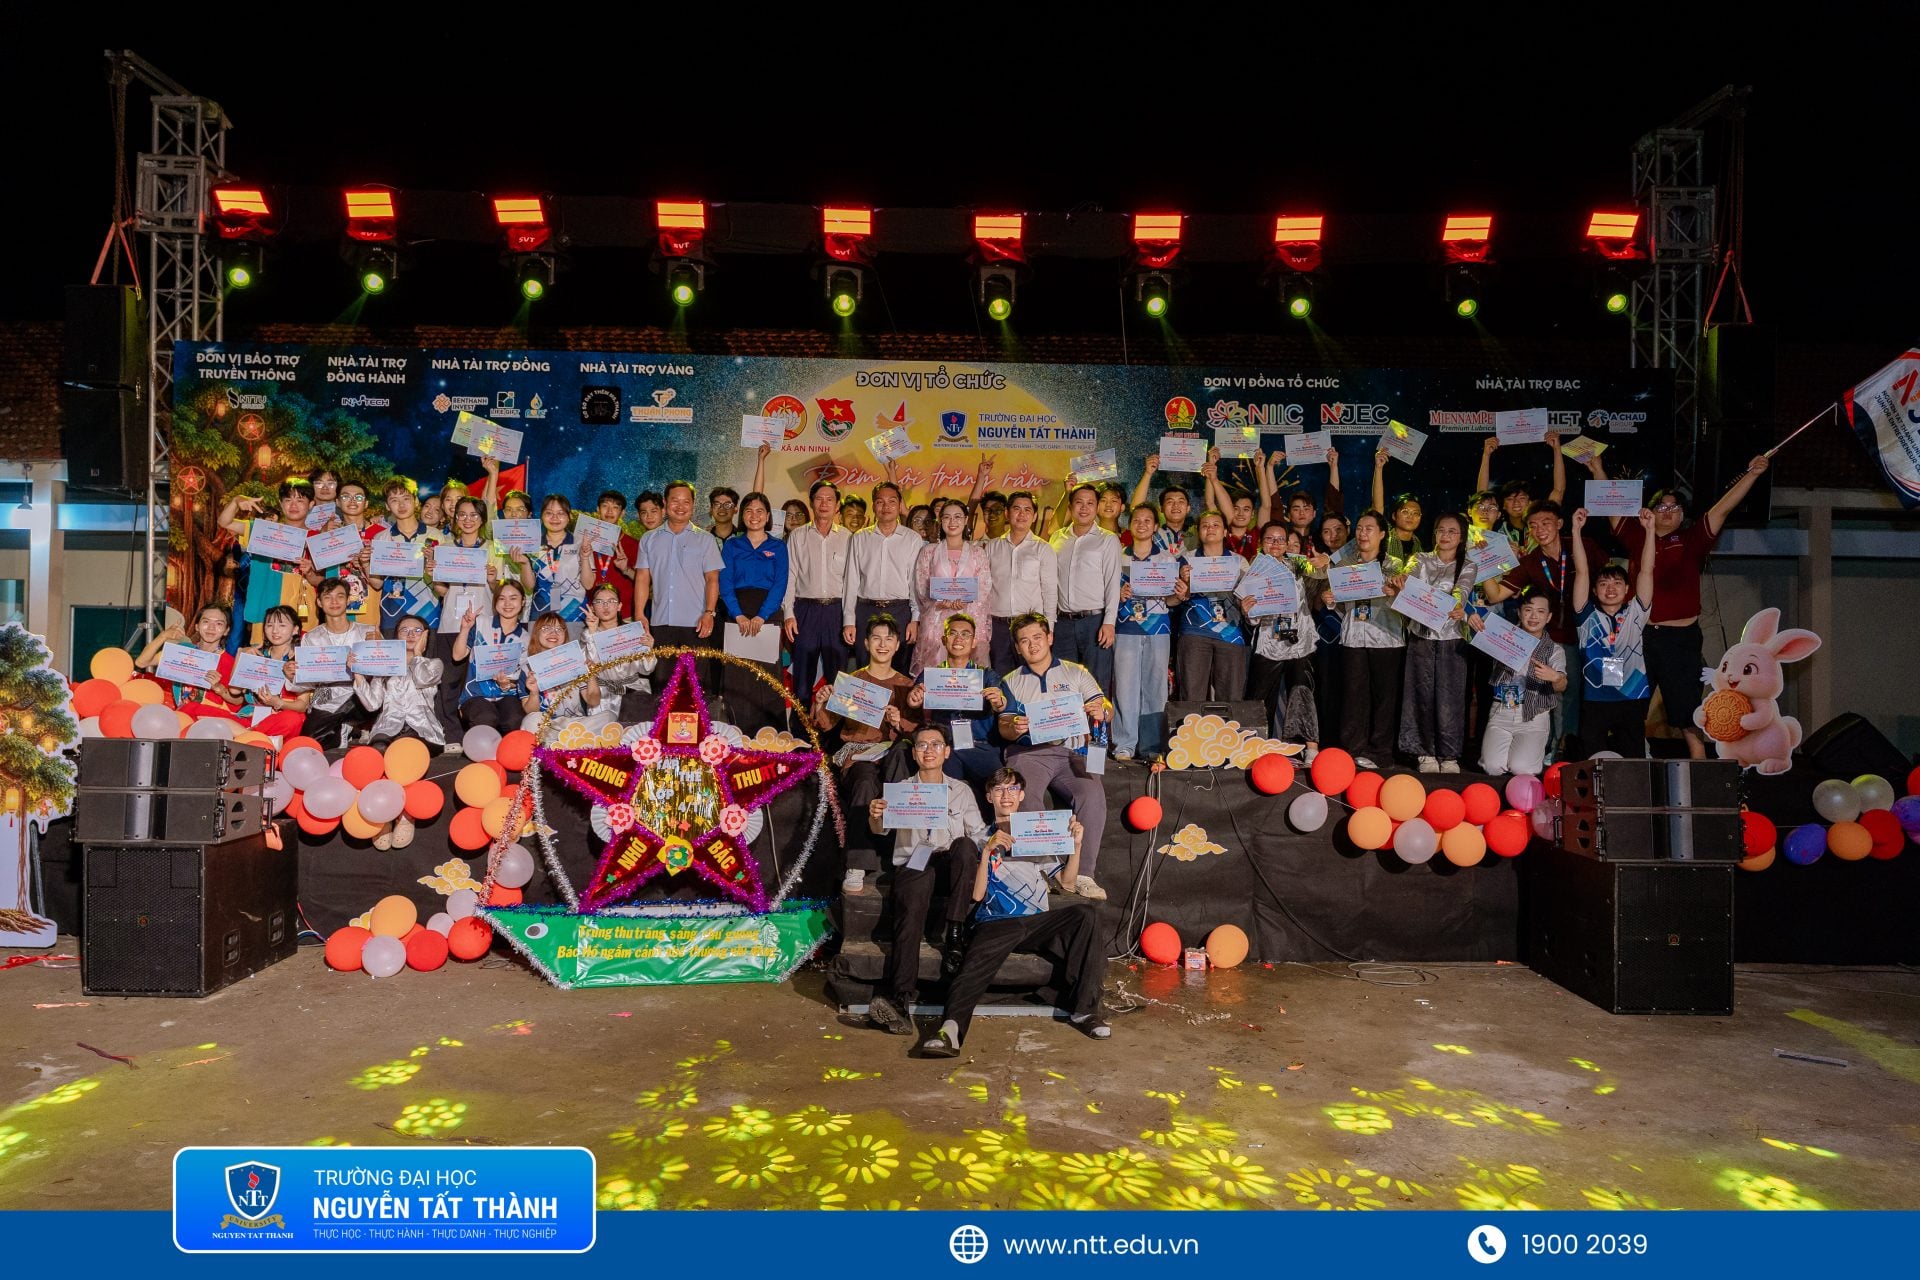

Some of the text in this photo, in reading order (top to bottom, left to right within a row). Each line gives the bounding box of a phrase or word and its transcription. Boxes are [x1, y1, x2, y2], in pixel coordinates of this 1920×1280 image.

[196, 351, 301, 368] ĐƠN VỊ BẢO TRỢ
[327, 355, 408, 371] NHÀ TÀI TRỢ
[431, 356, 551, 373] NHÀ TÀI TRỢ ĐỒNG
[198, 363, 296, 381] TRUYỀN THÔNG
[368, 371, 406, 384] HÀNH
[580, 362, 694, 377] NHÀ TÀI TRỢ VÀNG
[856, 365, 1006, 391] ĐƠN VỊ TỔ CHỨC
[1203, 377, 1231, 388] ĐƠN
[1233, 377, 1247, 390] VỊ
[1248, 373, 1286, 388] ĐỒNG
[1305, 376, 1340, 389] CHỨC
[1475, 377, 1581, 392] NHÀ TÀI TRỢ BẠC
[979, 412, 1057, 425] TRƯỜNG ĐẠI HỌC
[1248, 403, 1304, 425] NIIC
[978, 424, 1096, 440] NGUYỄN TẤT THÀNH
[808, 445, 831, 453] NINH
[578, 757, 628, 788] TRUNG
[616, 836, 648, 871] NHỚ
[707, 839, 737, 870] BÁC
[579, 925, 612, 940] Trung
[614, 926, 633, 939] thu
[635, 926, 666, 941] trăng
[670, 926, 698, 941] sáng
[557, 944, 578, 959] Bác
[583, 944, 600, 958] Hồ
[599, 943, 632, 960] ngắm
